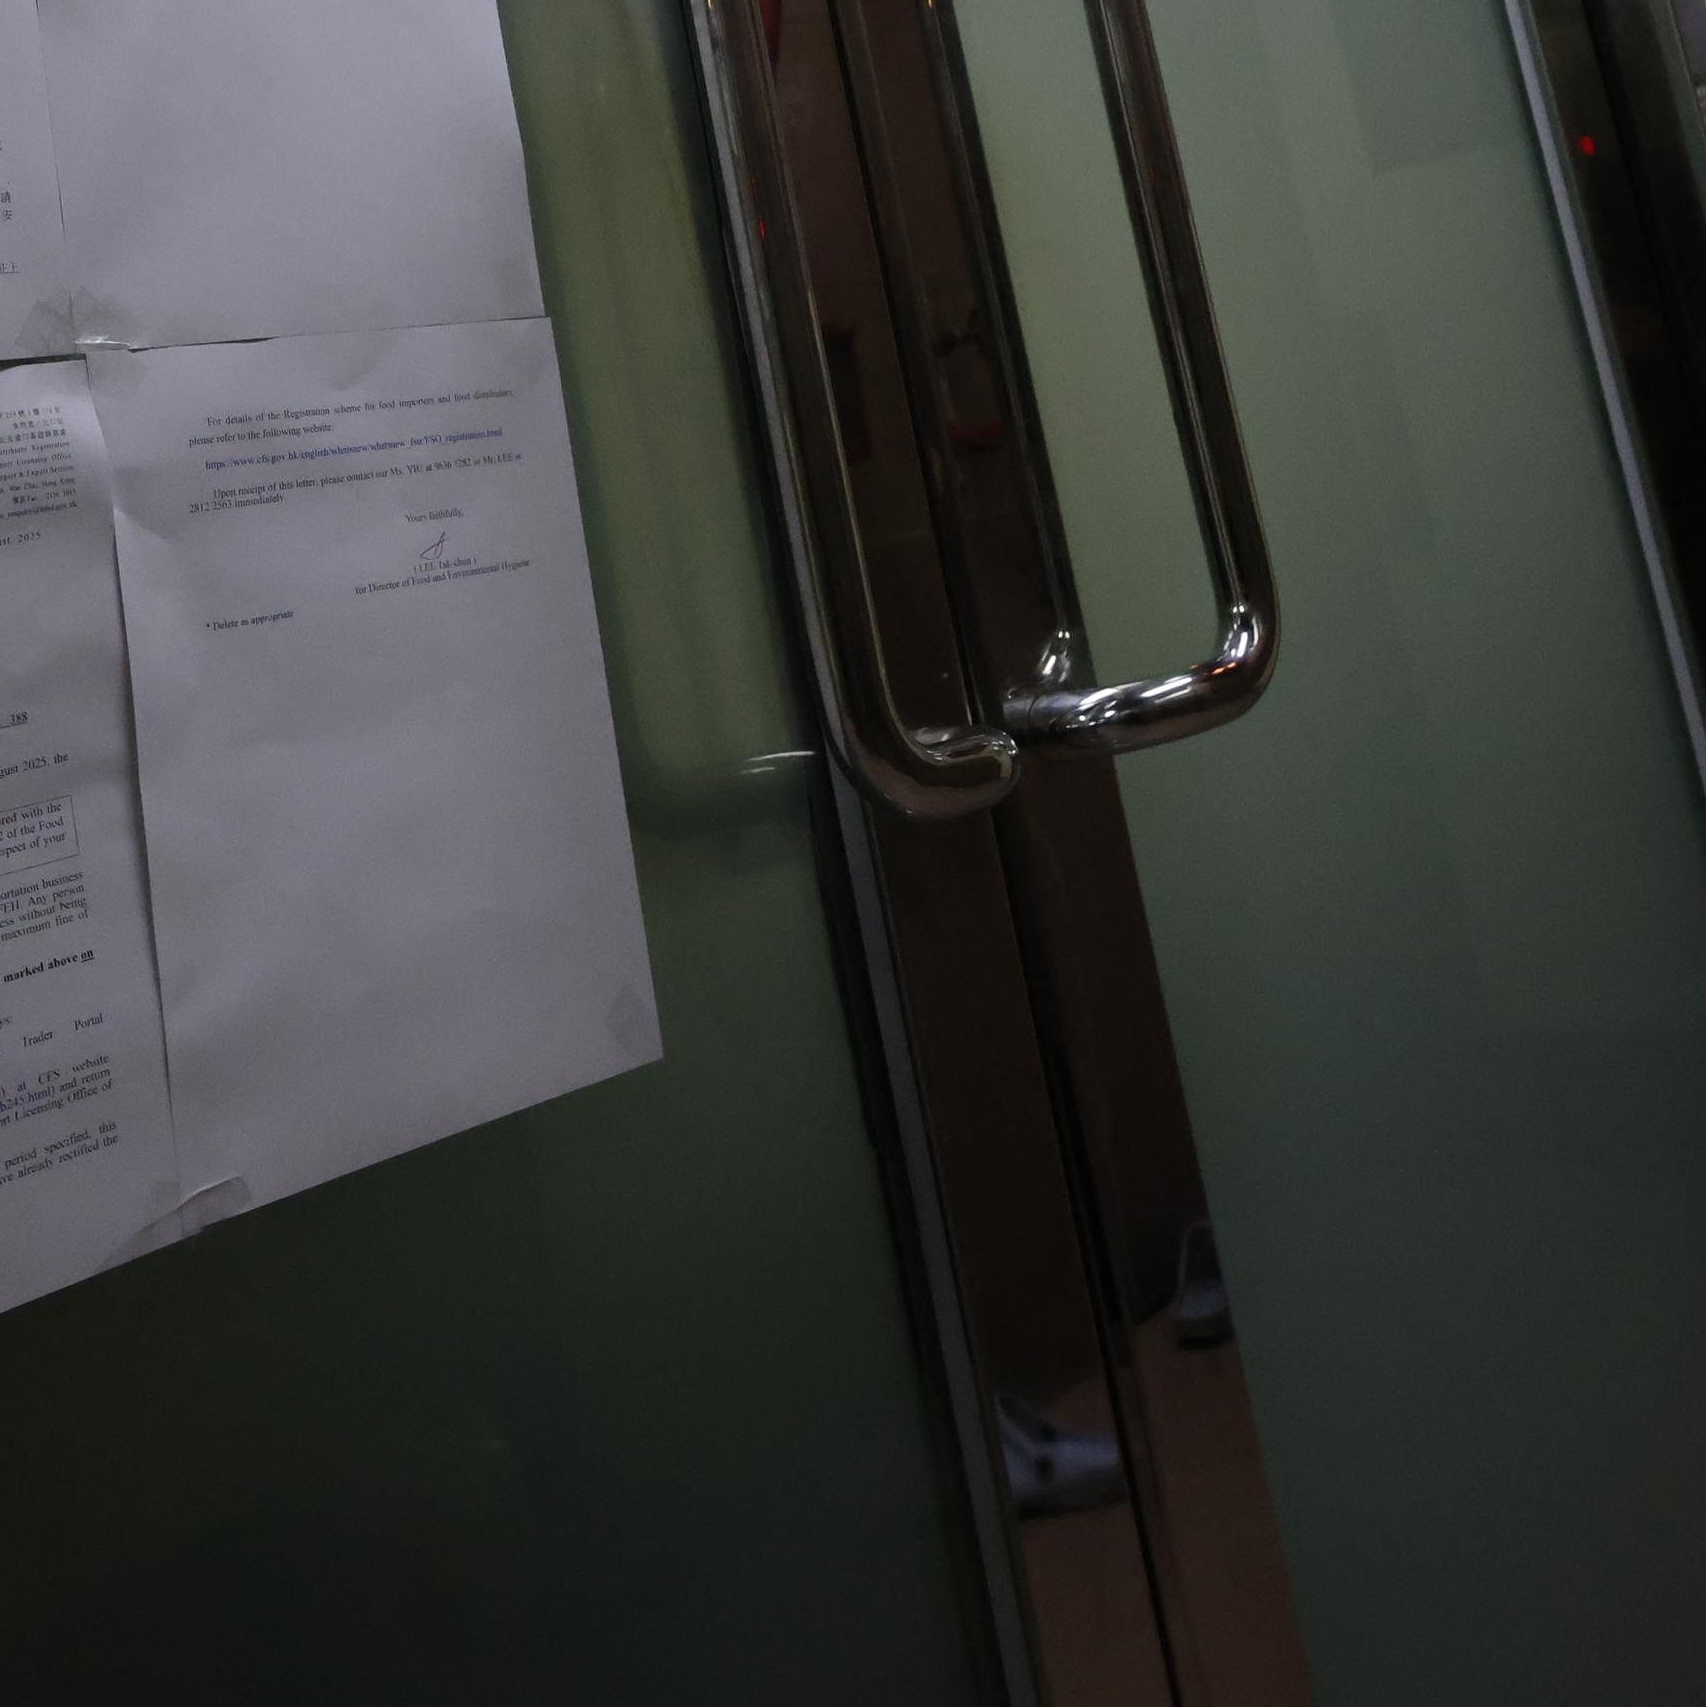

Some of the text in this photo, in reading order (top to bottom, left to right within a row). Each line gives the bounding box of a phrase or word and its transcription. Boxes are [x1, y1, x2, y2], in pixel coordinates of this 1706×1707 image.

[187, 435, 215, 449] please
[215, 431, 236, 443] refer
[236, 432, 246, 441] to
[246, 429, 261, 440] the
[261, 426, 302, 439] following
[16, 530, 42, 544] 2025
[21, 755, 51, 772] 2025,
[52, 752, 69, 765] the
[2, 960, 45, 983] marked
[46, 953, 79, 970] above
[79, 948, 94, 961] on
